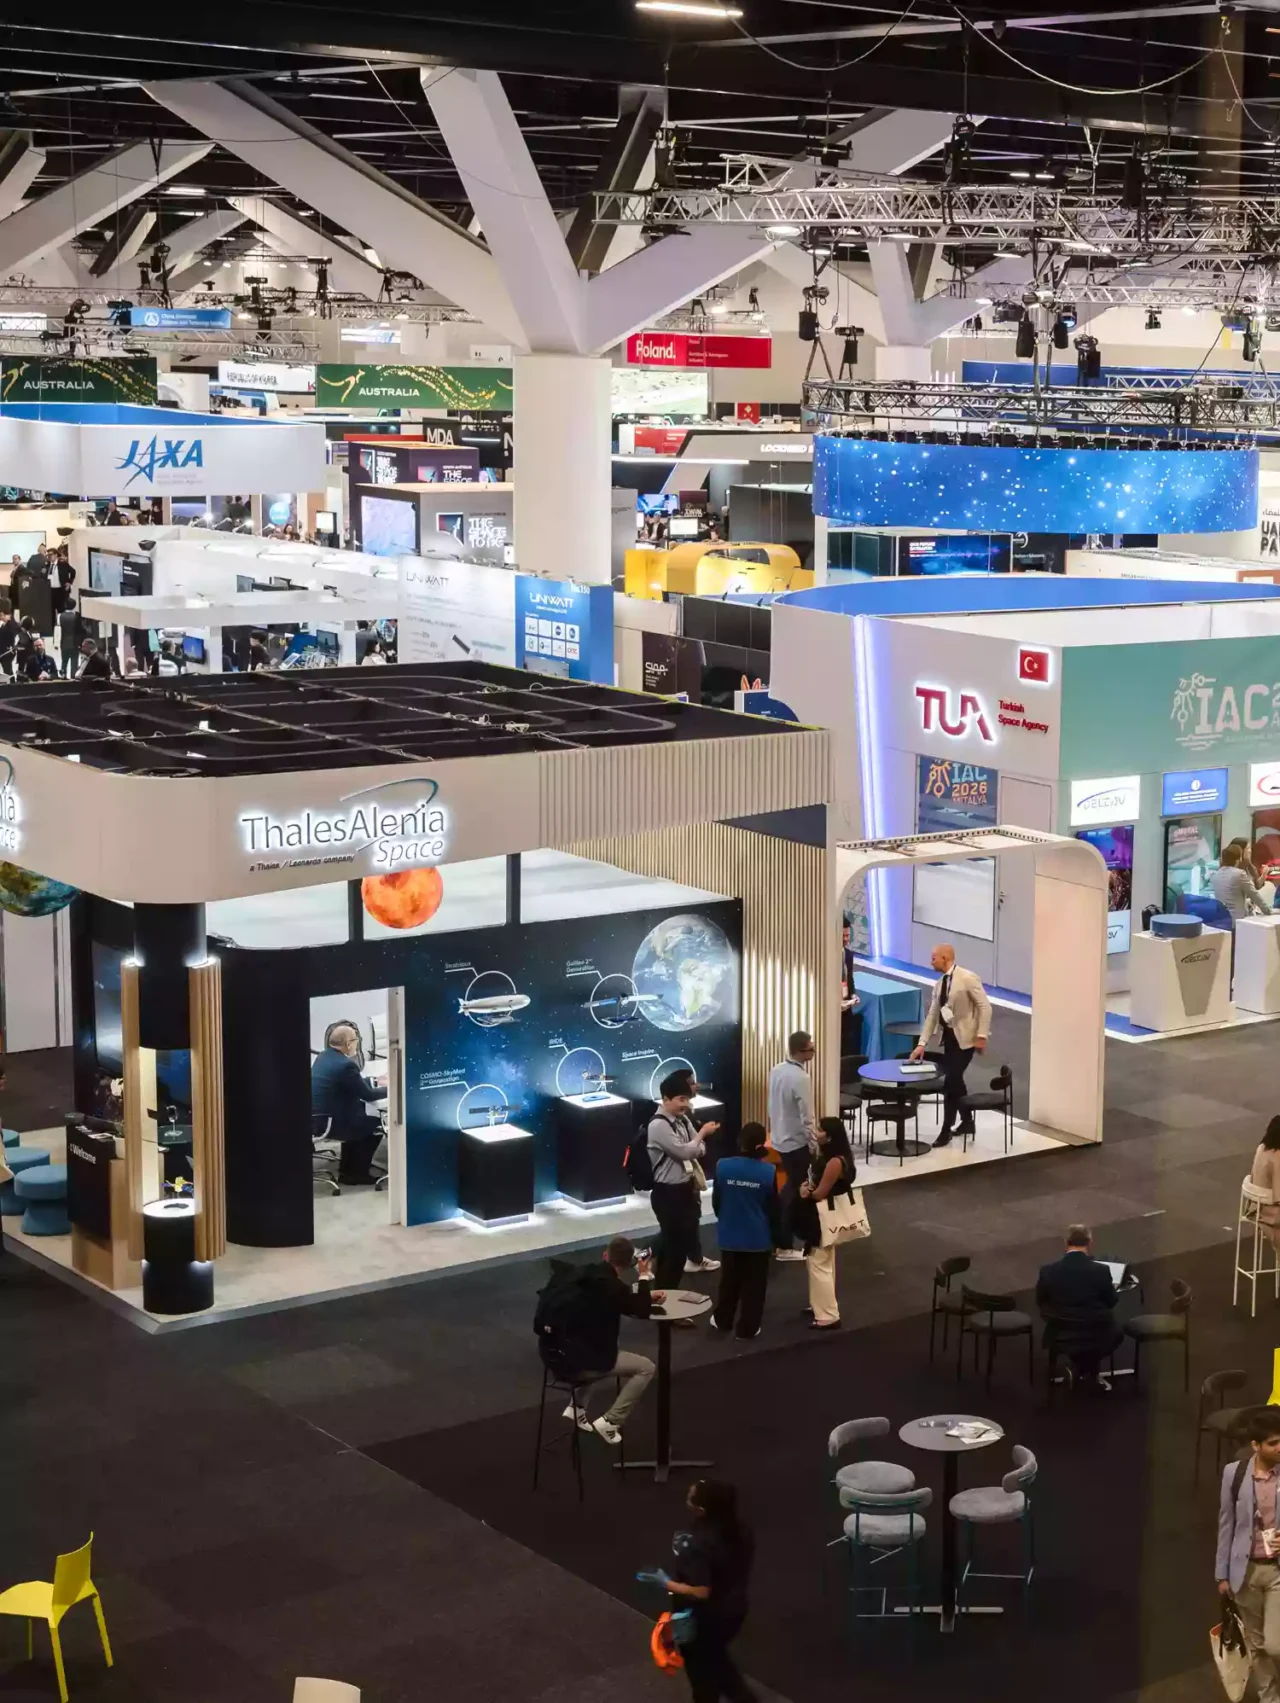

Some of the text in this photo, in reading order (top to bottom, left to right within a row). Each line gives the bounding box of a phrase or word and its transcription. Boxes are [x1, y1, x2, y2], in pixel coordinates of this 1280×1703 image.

[635, 340, 676, 359] Poland.
[23, 380, 95, 391] AUSTRALIA
[358, 387, 420, 397] AUSTRALIA
[426, 427, 454, 445] MDA
[114, 435, 204, 485] JAXA
[529, 591, 574, 608] UNIWATT
[916, 686, 993, 741] TUA
[998, 699, 1025, 713] Turkish
[1195, 683, 1270, 735] IAC
[998, 714, 1049, 733] Space Agency
[951, 781, 988, 797] 2026
[242, 803, 445, 850] ThalesAlenia
[376, 839, 444, 867] Space
[257, 862, 280, 871] Thales
[289, 857, 322, 868] Leonardo
[323, 854, 355, 865] company
[566, 959, 584, 967] Galileo
[566, 964, 596, 973] Generation
[621, 1048, 655, 1059] Space Inspire
[419, 1068, 466, 1079] COSMO-SkyMed
[429, 1076, 460, 1084] Generation
[726, 1178, 761, 1189] IAC SUPPORT
[828, 1218, 865, 1234] VAST
